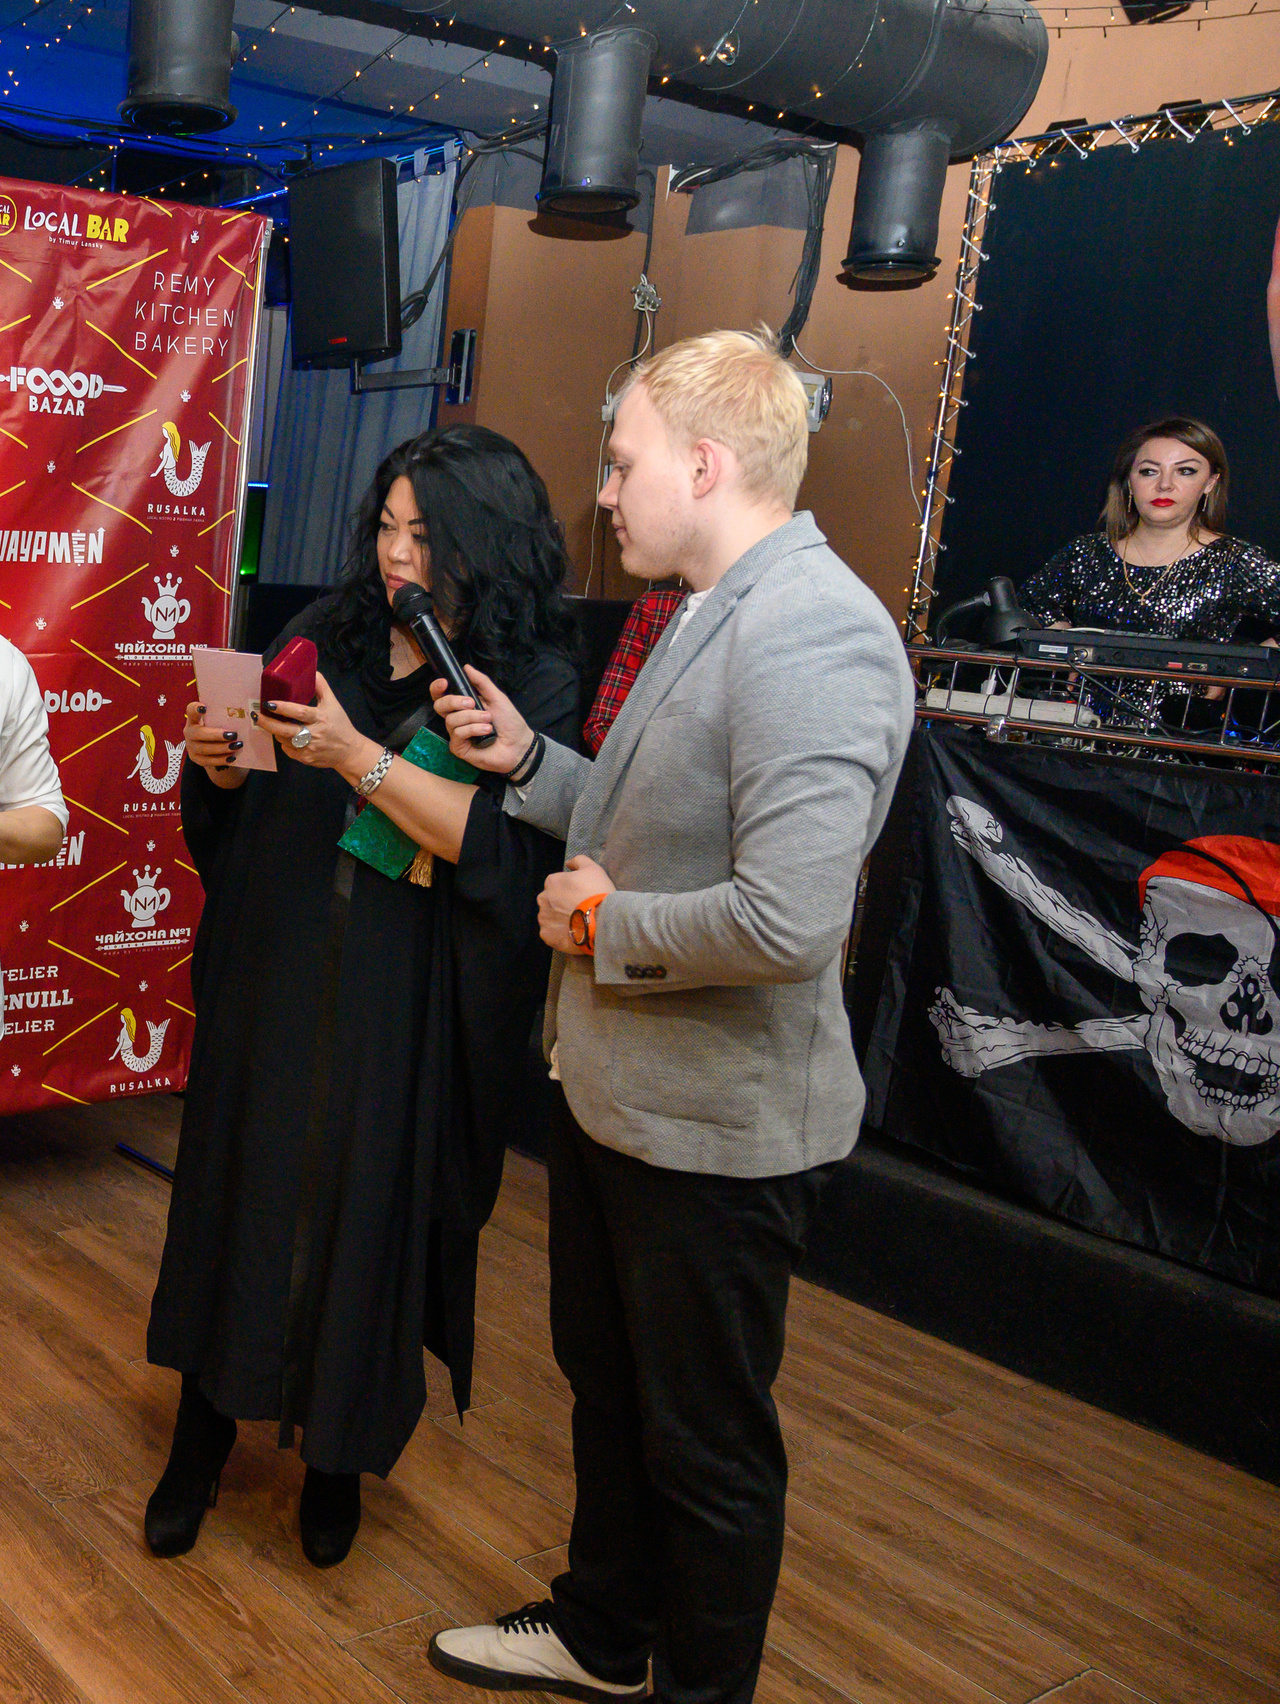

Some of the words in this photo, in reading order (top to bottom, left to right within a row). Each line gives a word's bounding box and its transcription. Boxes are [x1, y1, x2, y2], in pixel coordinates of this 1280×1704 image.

[24, 205, 82, 237] LOCAL
[86, 214, 129, 243] BAR
[153, 271, 215, 296] REMY
[135, 300, 234, 328] KITCHEN
[135, 331, 228, 357] BAKERY
[29, 395, 85, 416] BAZAR
[147, 503, 206, 517] RUSALKA
[114, 640, 186, 653] ЧАЙХОНА
[95, 930, 167, 944] ЧАЙХОНА
[110, 1077, 171, 1093] RUSALKA
